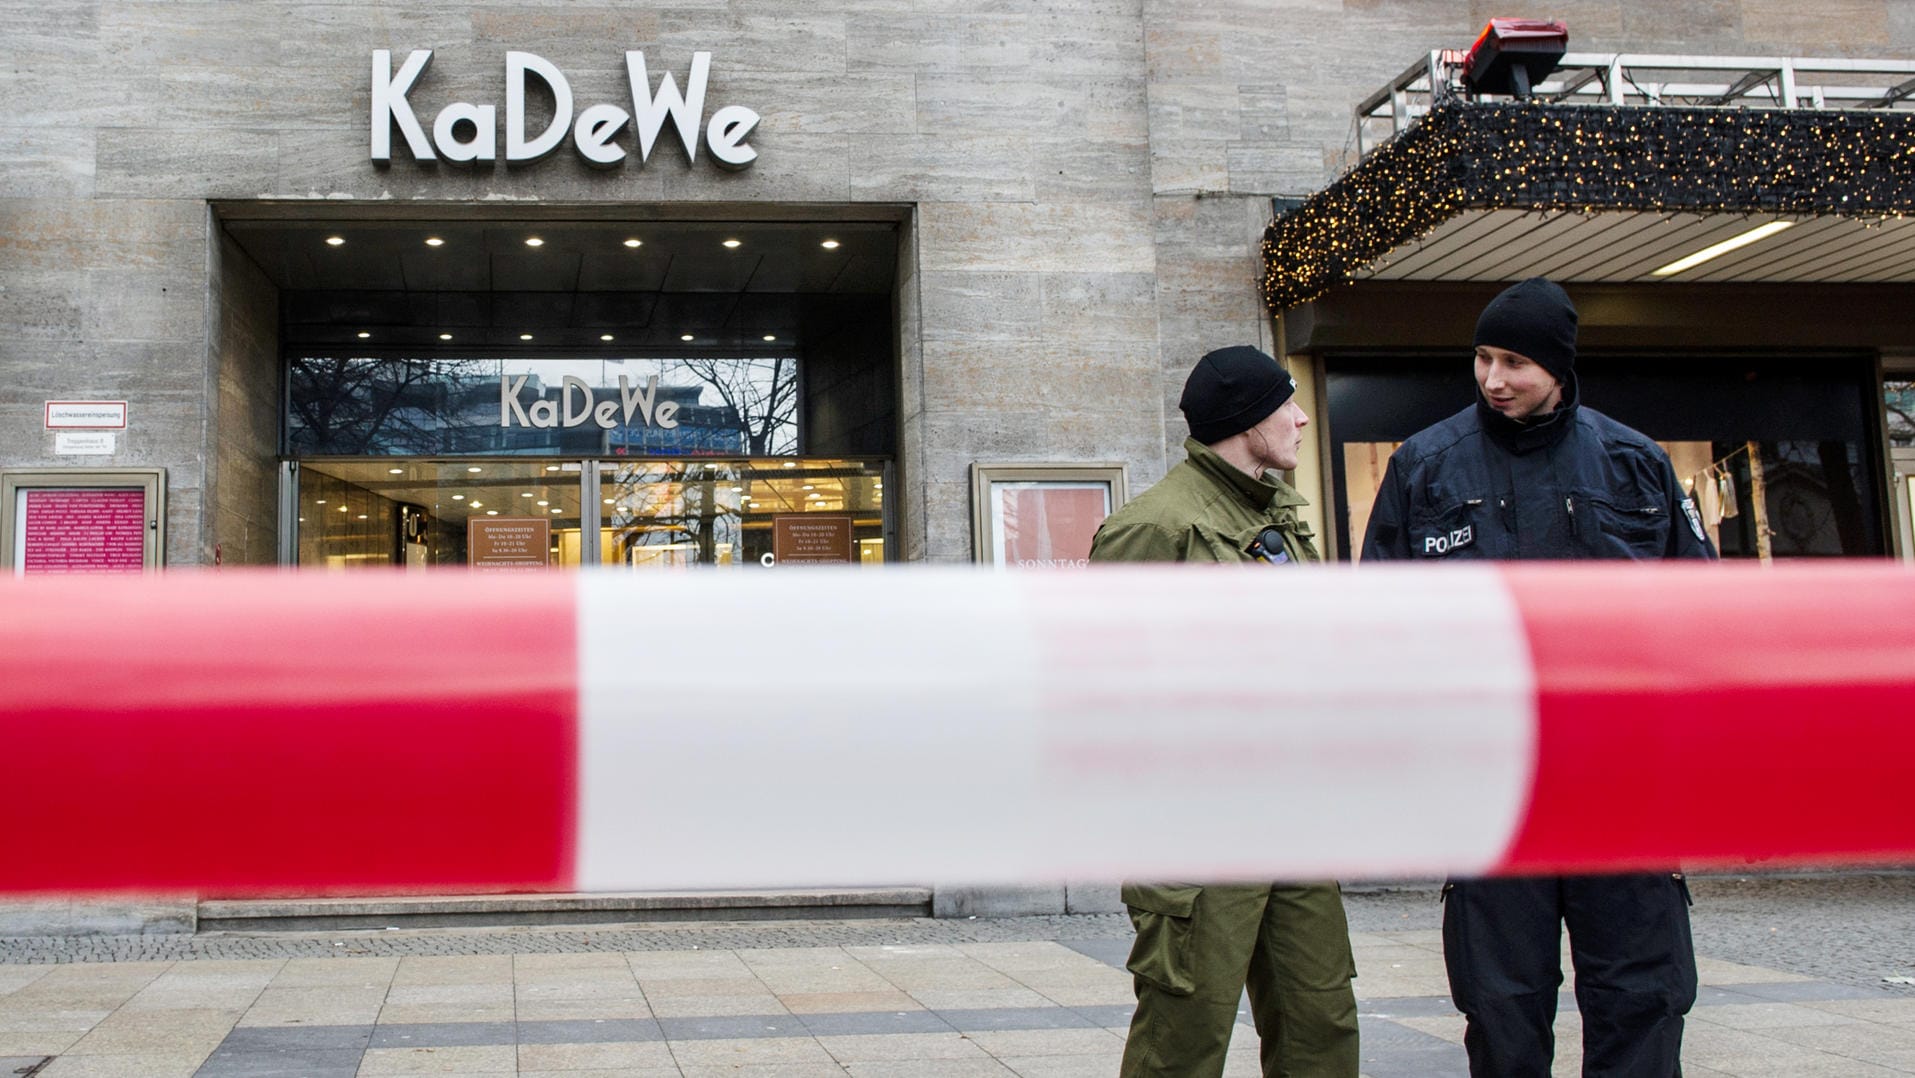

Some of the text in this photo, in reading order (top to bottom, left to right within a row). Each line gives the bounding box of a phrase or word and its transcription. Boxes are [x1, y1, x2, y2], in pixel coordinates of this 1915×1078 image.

[370, 49, 761, 170] KaDeWe
[500, 374, 679, 429] KaDeWe
[1425, 525, 1472, 553] POLIZEI
